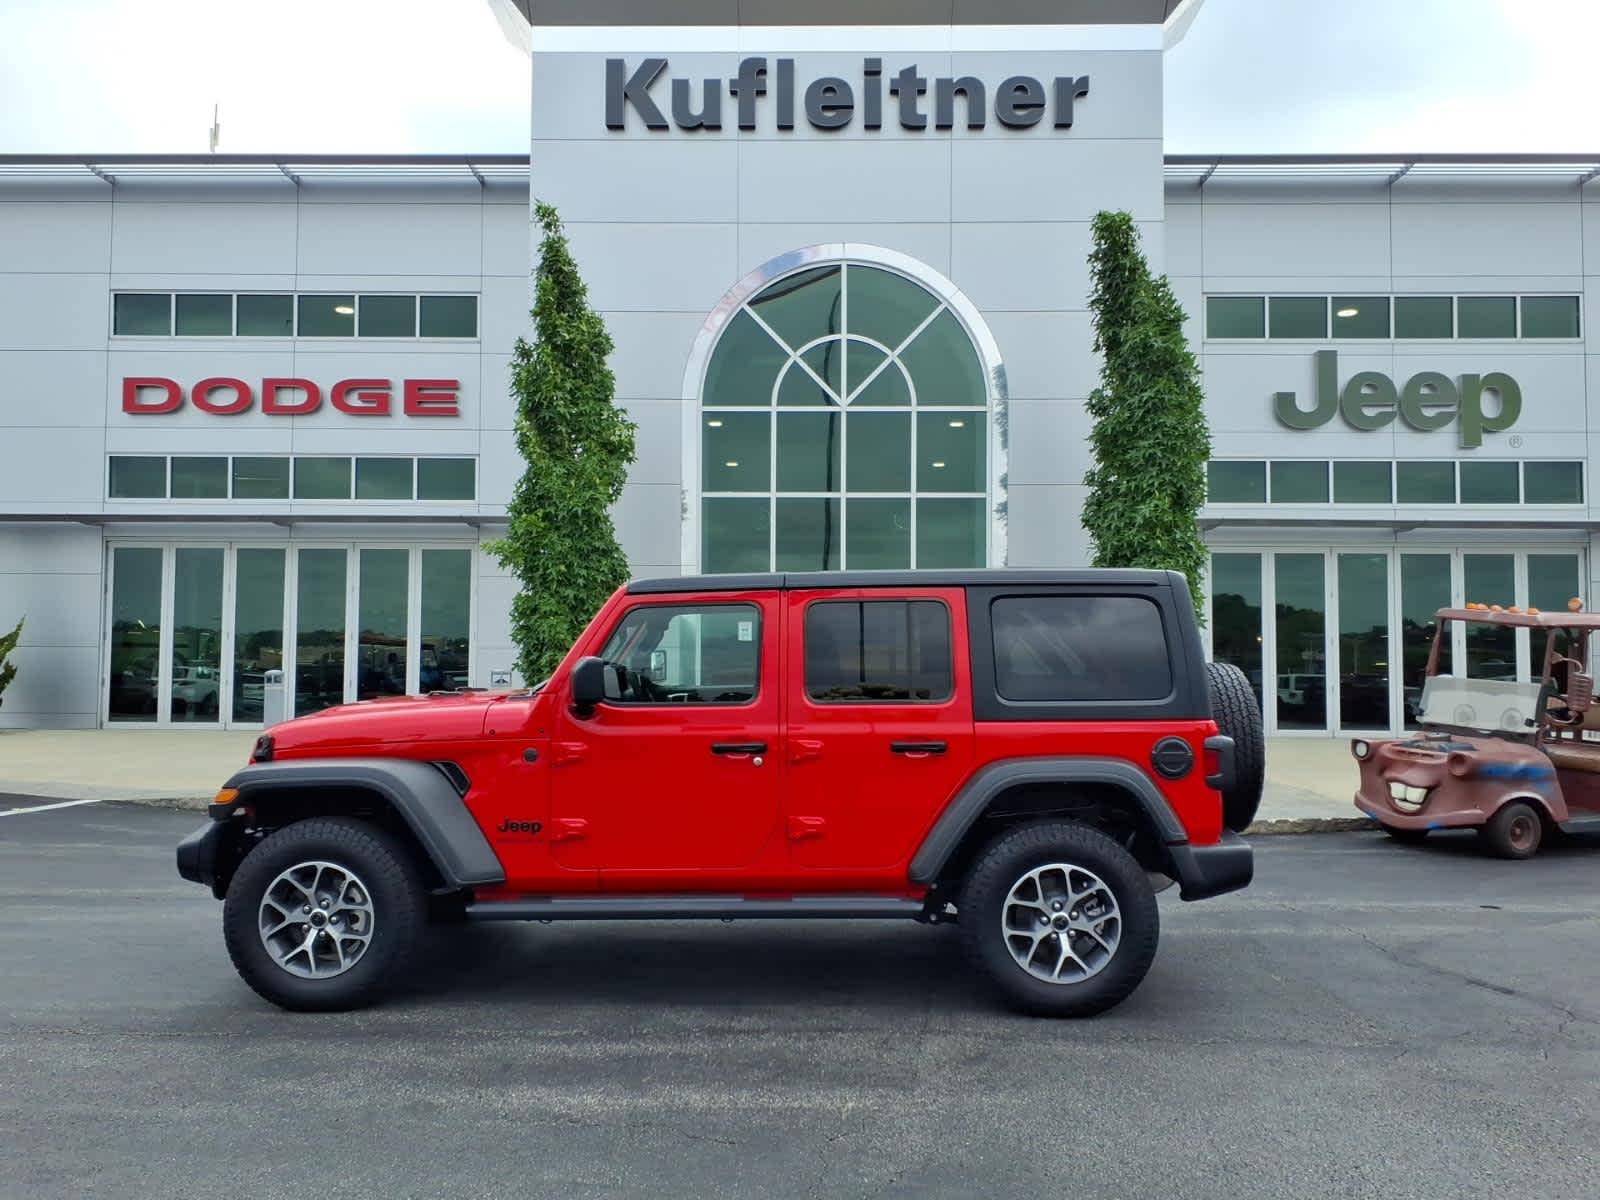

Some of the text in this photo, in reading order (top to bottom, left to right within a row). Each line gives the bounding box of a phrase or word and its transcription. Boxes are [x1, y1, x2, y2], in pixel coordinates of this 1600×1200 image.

[606, 57, 1089, 130] Kufleitner
[122, 377, 459, 416] DODGE
[1274, 350, 1522, 448] Jeep
[498, 816, 543, 836] Jeep
